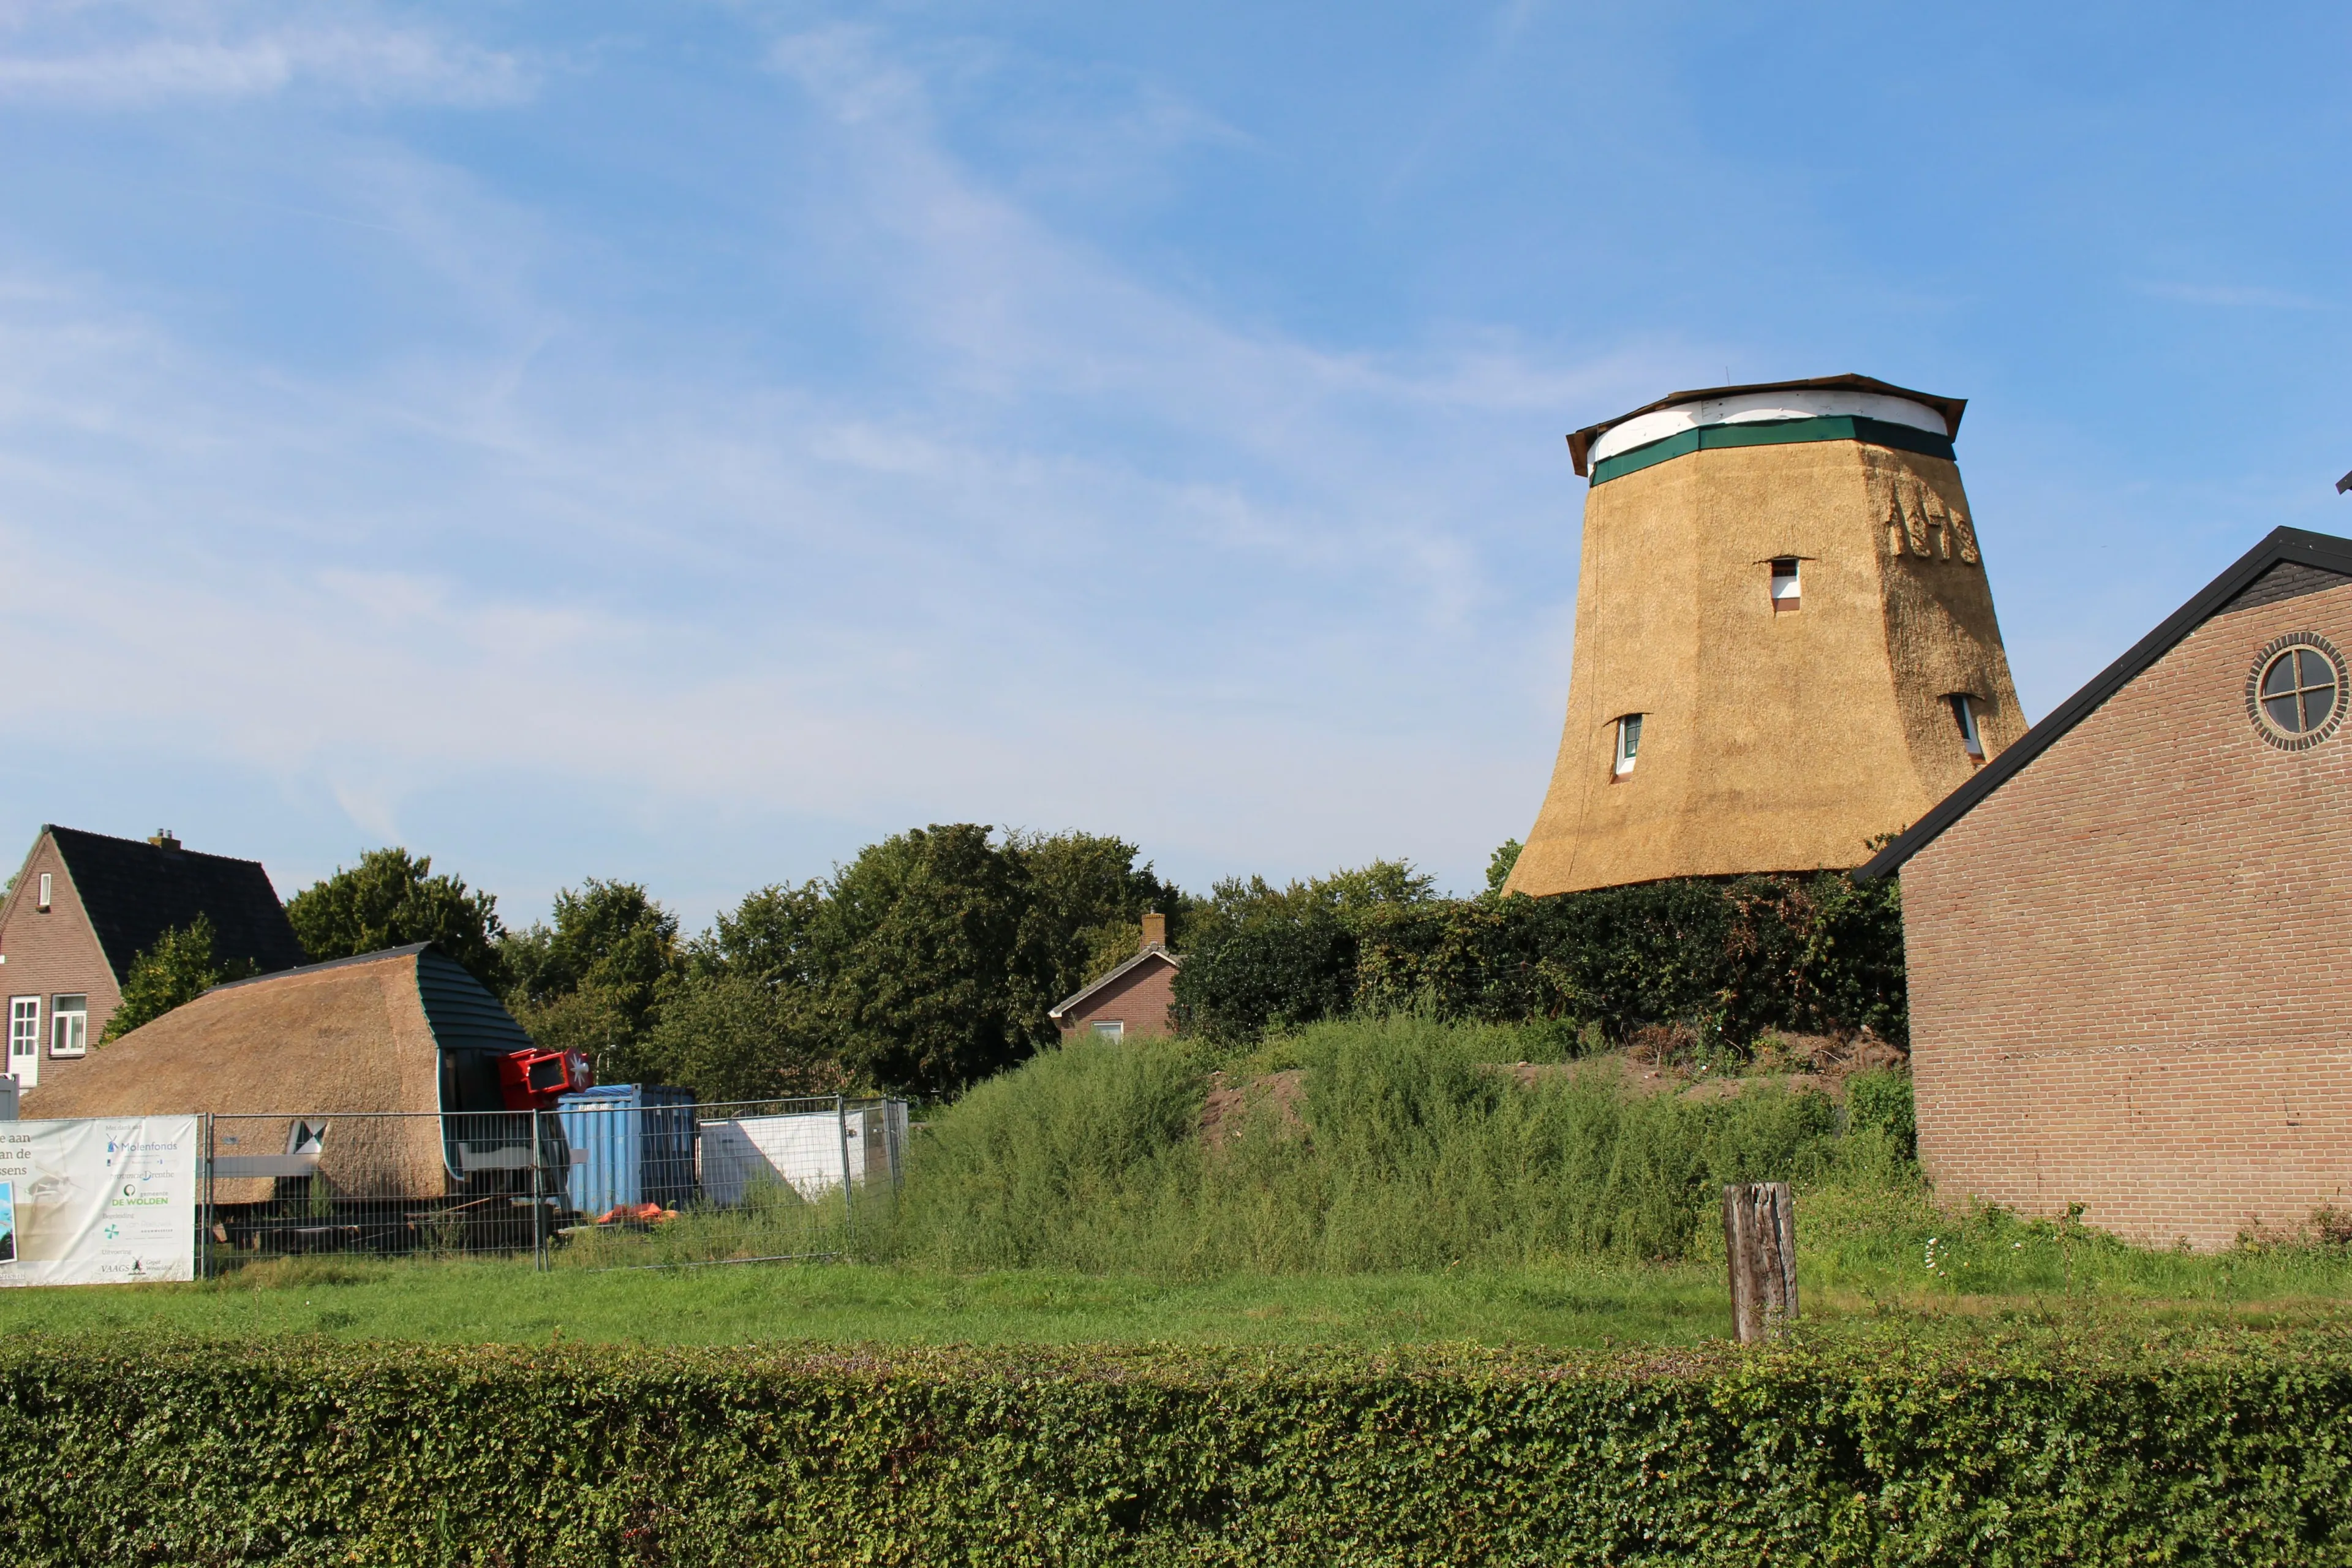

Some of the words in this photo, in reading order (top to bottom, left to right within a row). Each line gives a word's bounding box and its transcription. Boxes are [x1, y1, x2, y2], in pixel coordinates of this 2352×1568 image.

[9, 1134, 31, 1143] aan
[121, 1142, 178, 1152] Molenfonds
[17, 1148, 31, 1159] de
[143, 1170, 175, 1181] Drenthe
